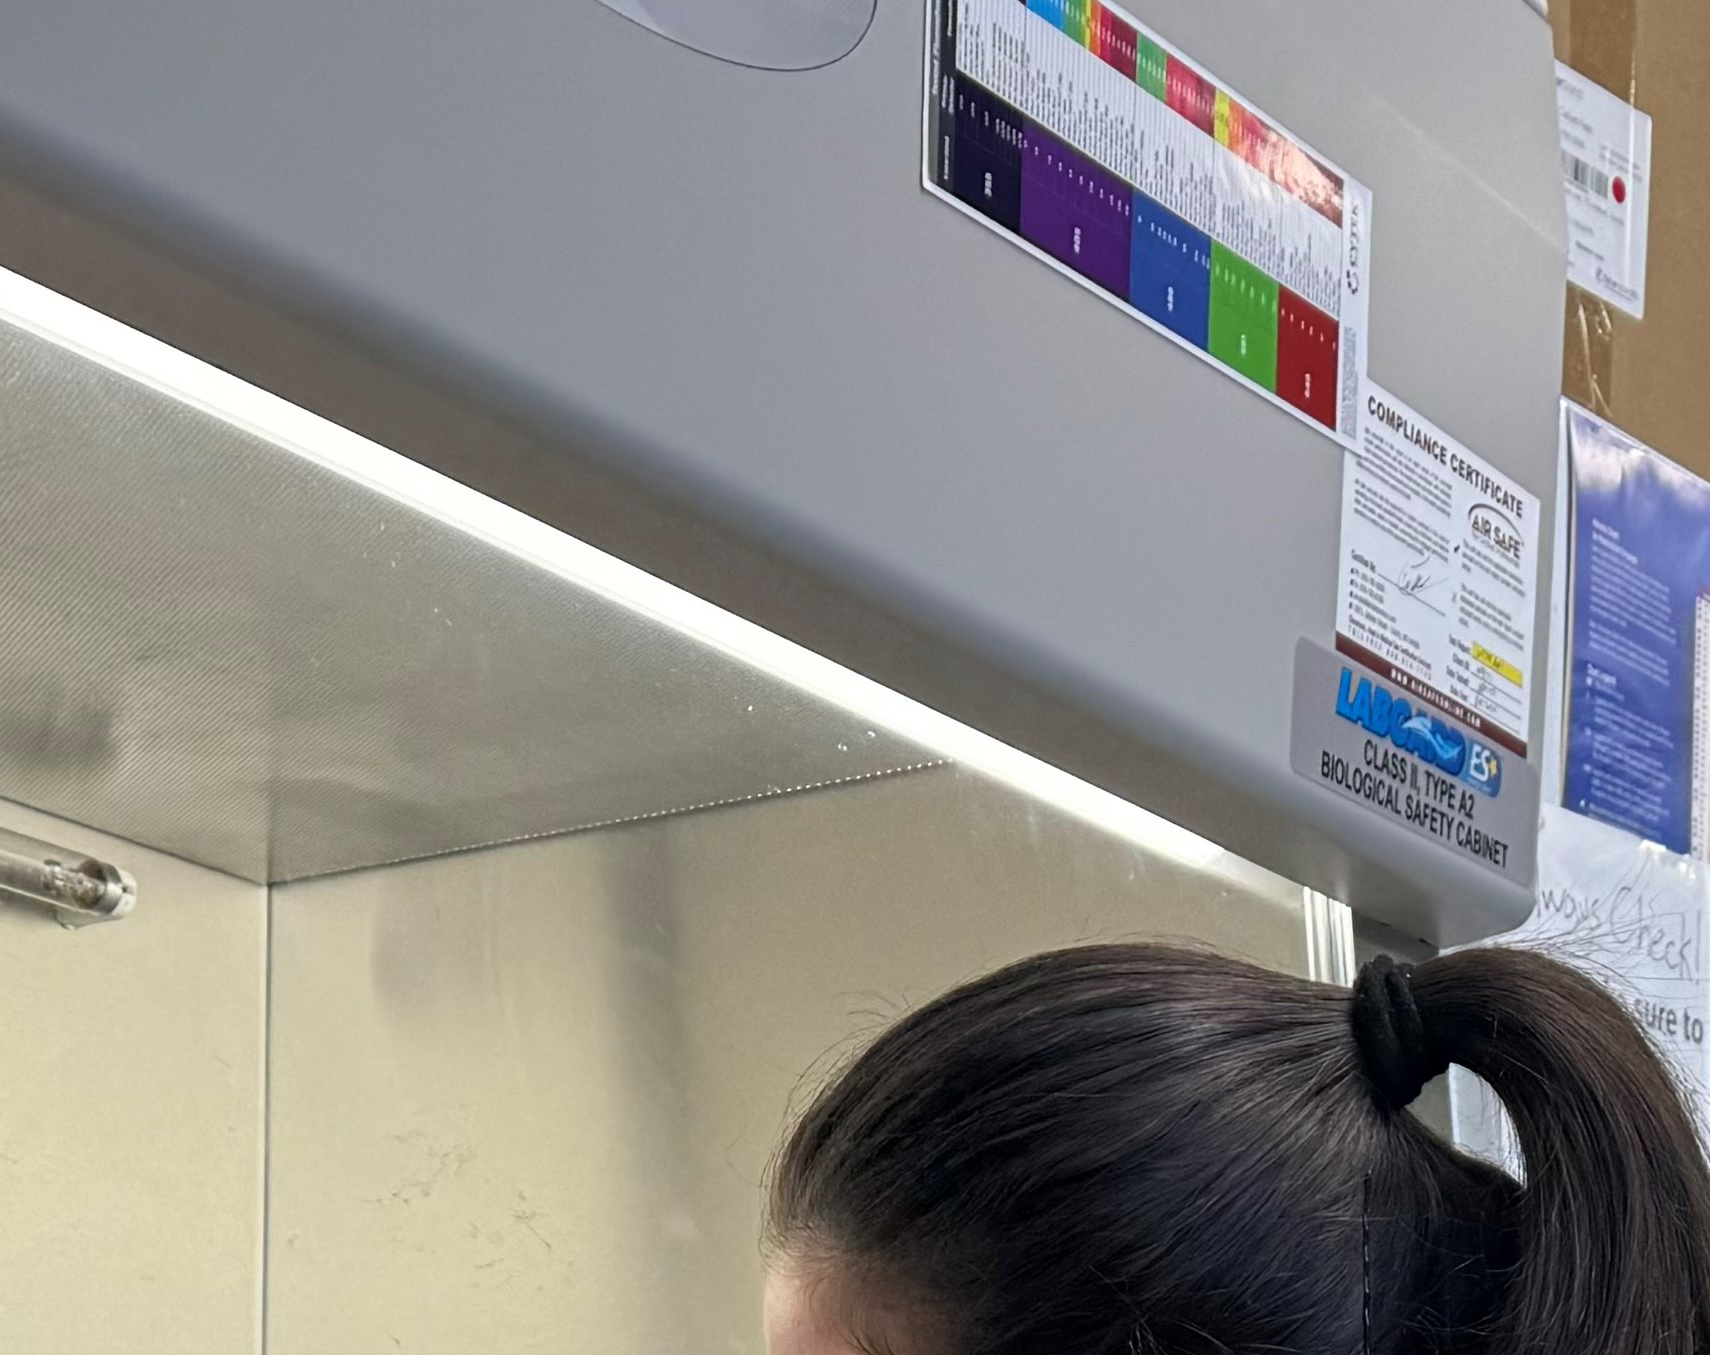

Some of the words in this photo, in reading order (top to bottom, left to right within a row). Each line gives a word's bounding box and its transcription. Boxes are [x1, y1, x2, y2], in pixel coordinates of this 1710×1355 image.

[1368, 398, 1447, 465] COMPLIANCE
[1450, 454, 1523, 518] CERTIFICATE
[1364, 740, 1407, 784] CLASS
[1424, 770, 1456, 809] TYPE
[1458, 790, 1474, 820] A2
[1470, 744, 1491, 782] ES
[1321, 752, 1402, 814] BIOLOGICAL
[1405, 795, 1454, 839] SAFETY
[1456, 822, 1508, 866] CABINET
[1684, 1012, 1703, 1043] to
